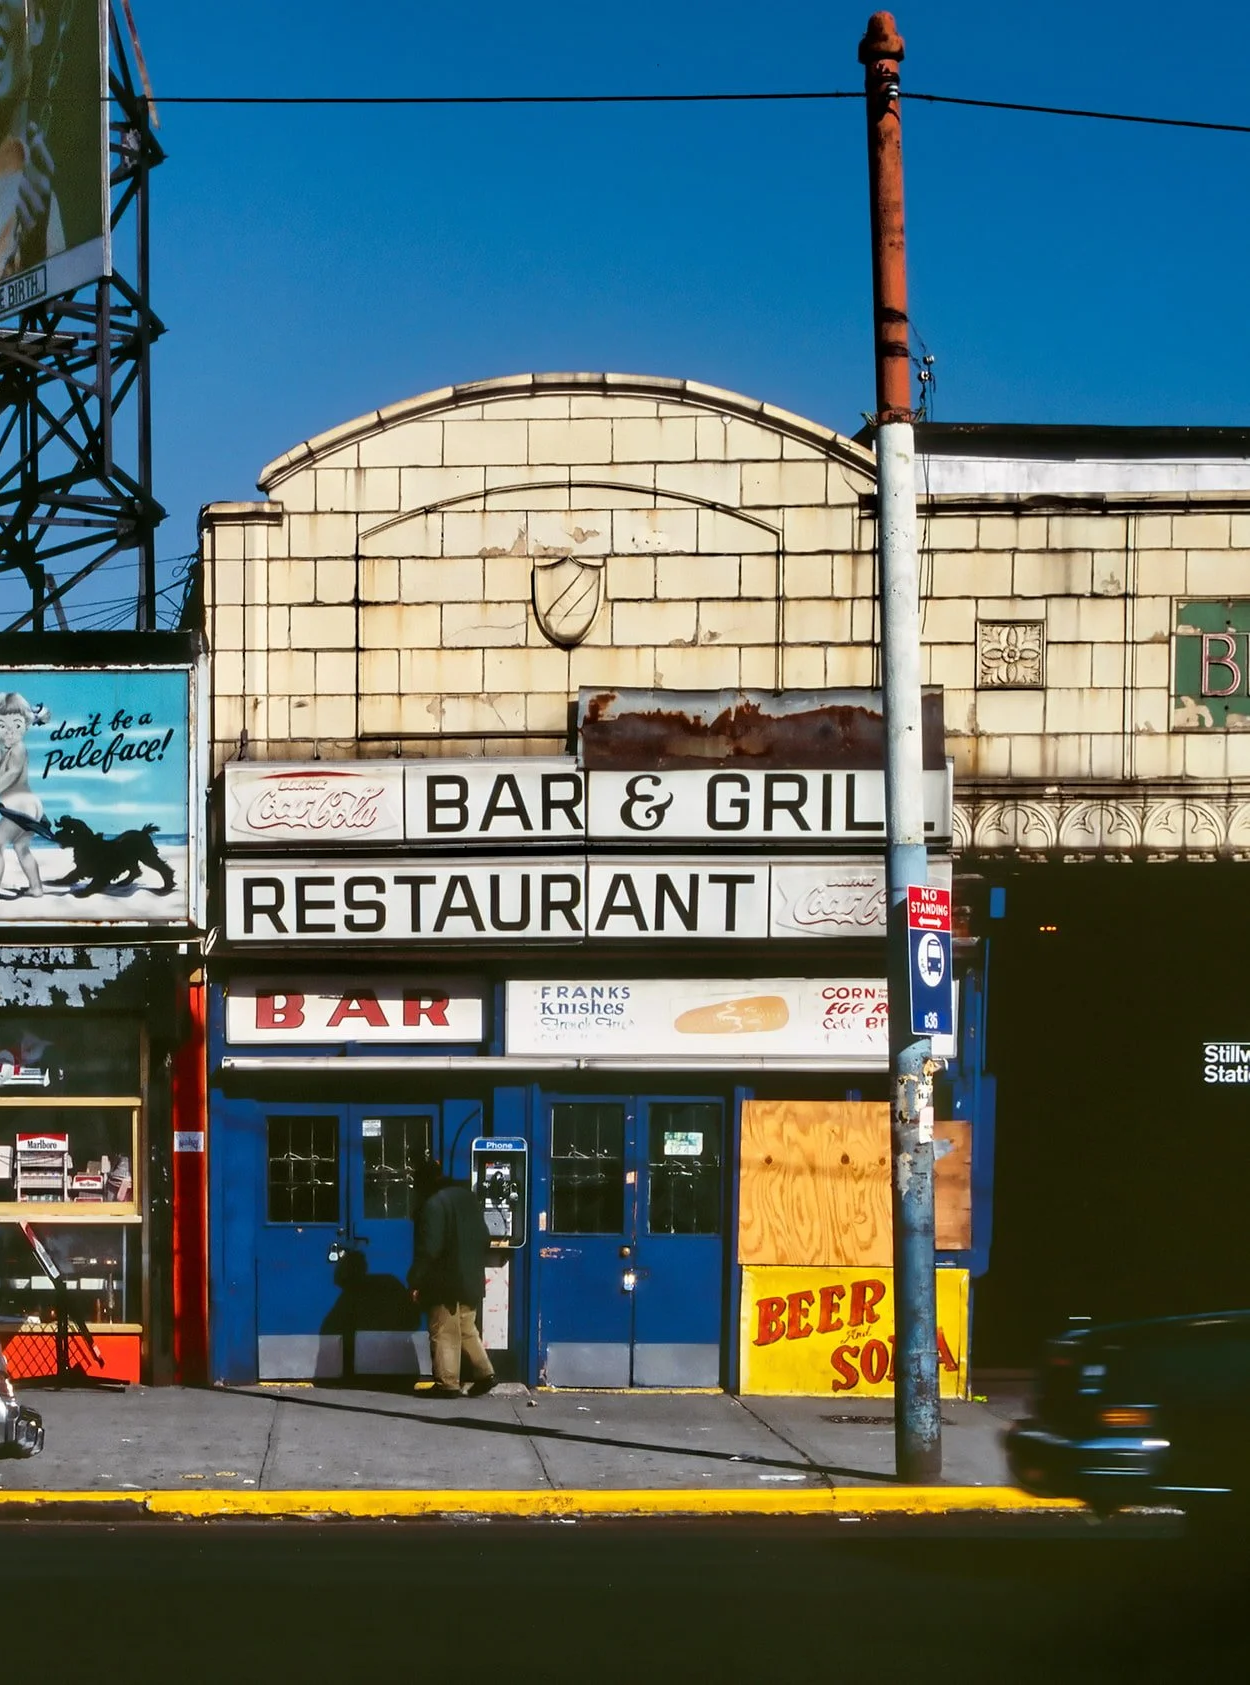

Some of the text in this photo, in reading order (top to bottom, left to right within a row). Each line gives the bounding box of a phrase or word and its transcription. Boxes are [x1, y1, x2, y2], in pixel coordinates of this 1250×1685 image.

[8, 275, 40, 307] BIRTH.
[50, 708, 153, 741] don't be a
[42, 728, 174, 779] Paleface!
[426, 773, 584, 833] BAR
[620, 774, 674, 832] &
[243, 873, 755, 934] RESTAURANT
[921, 888, 938, 902] NO
[911, 901, 949, 917] STANDING
[541, 986, 630, 999] FRANKS
[822, 987, 875, 1000] CORN
[254, 988, 451, 1028] BAR
[540, 998, 625, 1015] Knishes
[825, 1003, 866, 1015] EGG
[924, 1011, 938, 1029] B36
[1204, 1064, 1250, 1083] Stati
[27, 1139, 57, 1149] Marlboro
[486, 1141, 513, 1149] Phone
[752, 1279, 887, 1346] BEER
[830, 1326, 959, 1392] SOA
